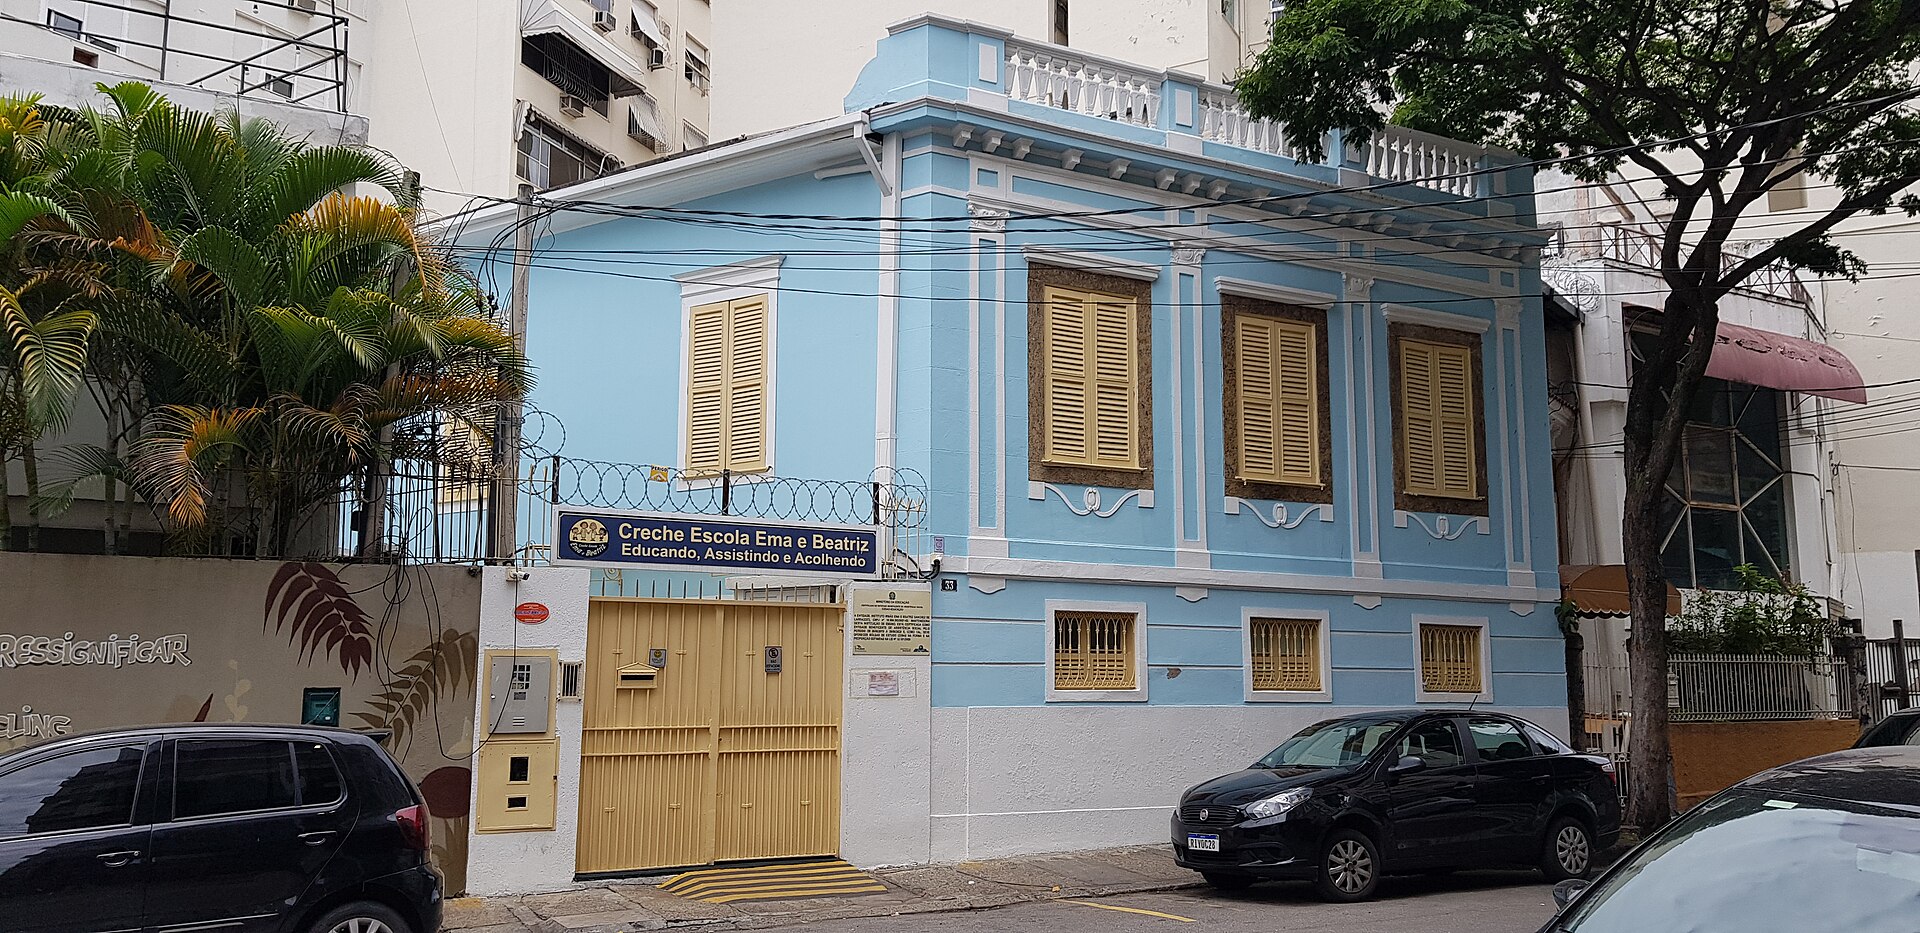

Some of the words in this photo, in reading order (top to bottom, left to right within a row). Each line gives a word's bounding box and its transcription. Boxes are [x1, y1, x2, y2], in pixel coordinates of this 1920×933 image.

[618, 523, 685, 542] Creche
[690, 527, 750, 546] Escola
[755, 530, 793, 548] Ema
[797, 536, 808, 549] e
[812, 534, 870, 552] Beatriz
[621, 543, 701, 561] Educando,
[703, 547, 780, 563] Assistindo
[783, 553, 792, 563] e
[794, 552, 866, 567] Acolhendo
[945, 580, 954, 590] 33
